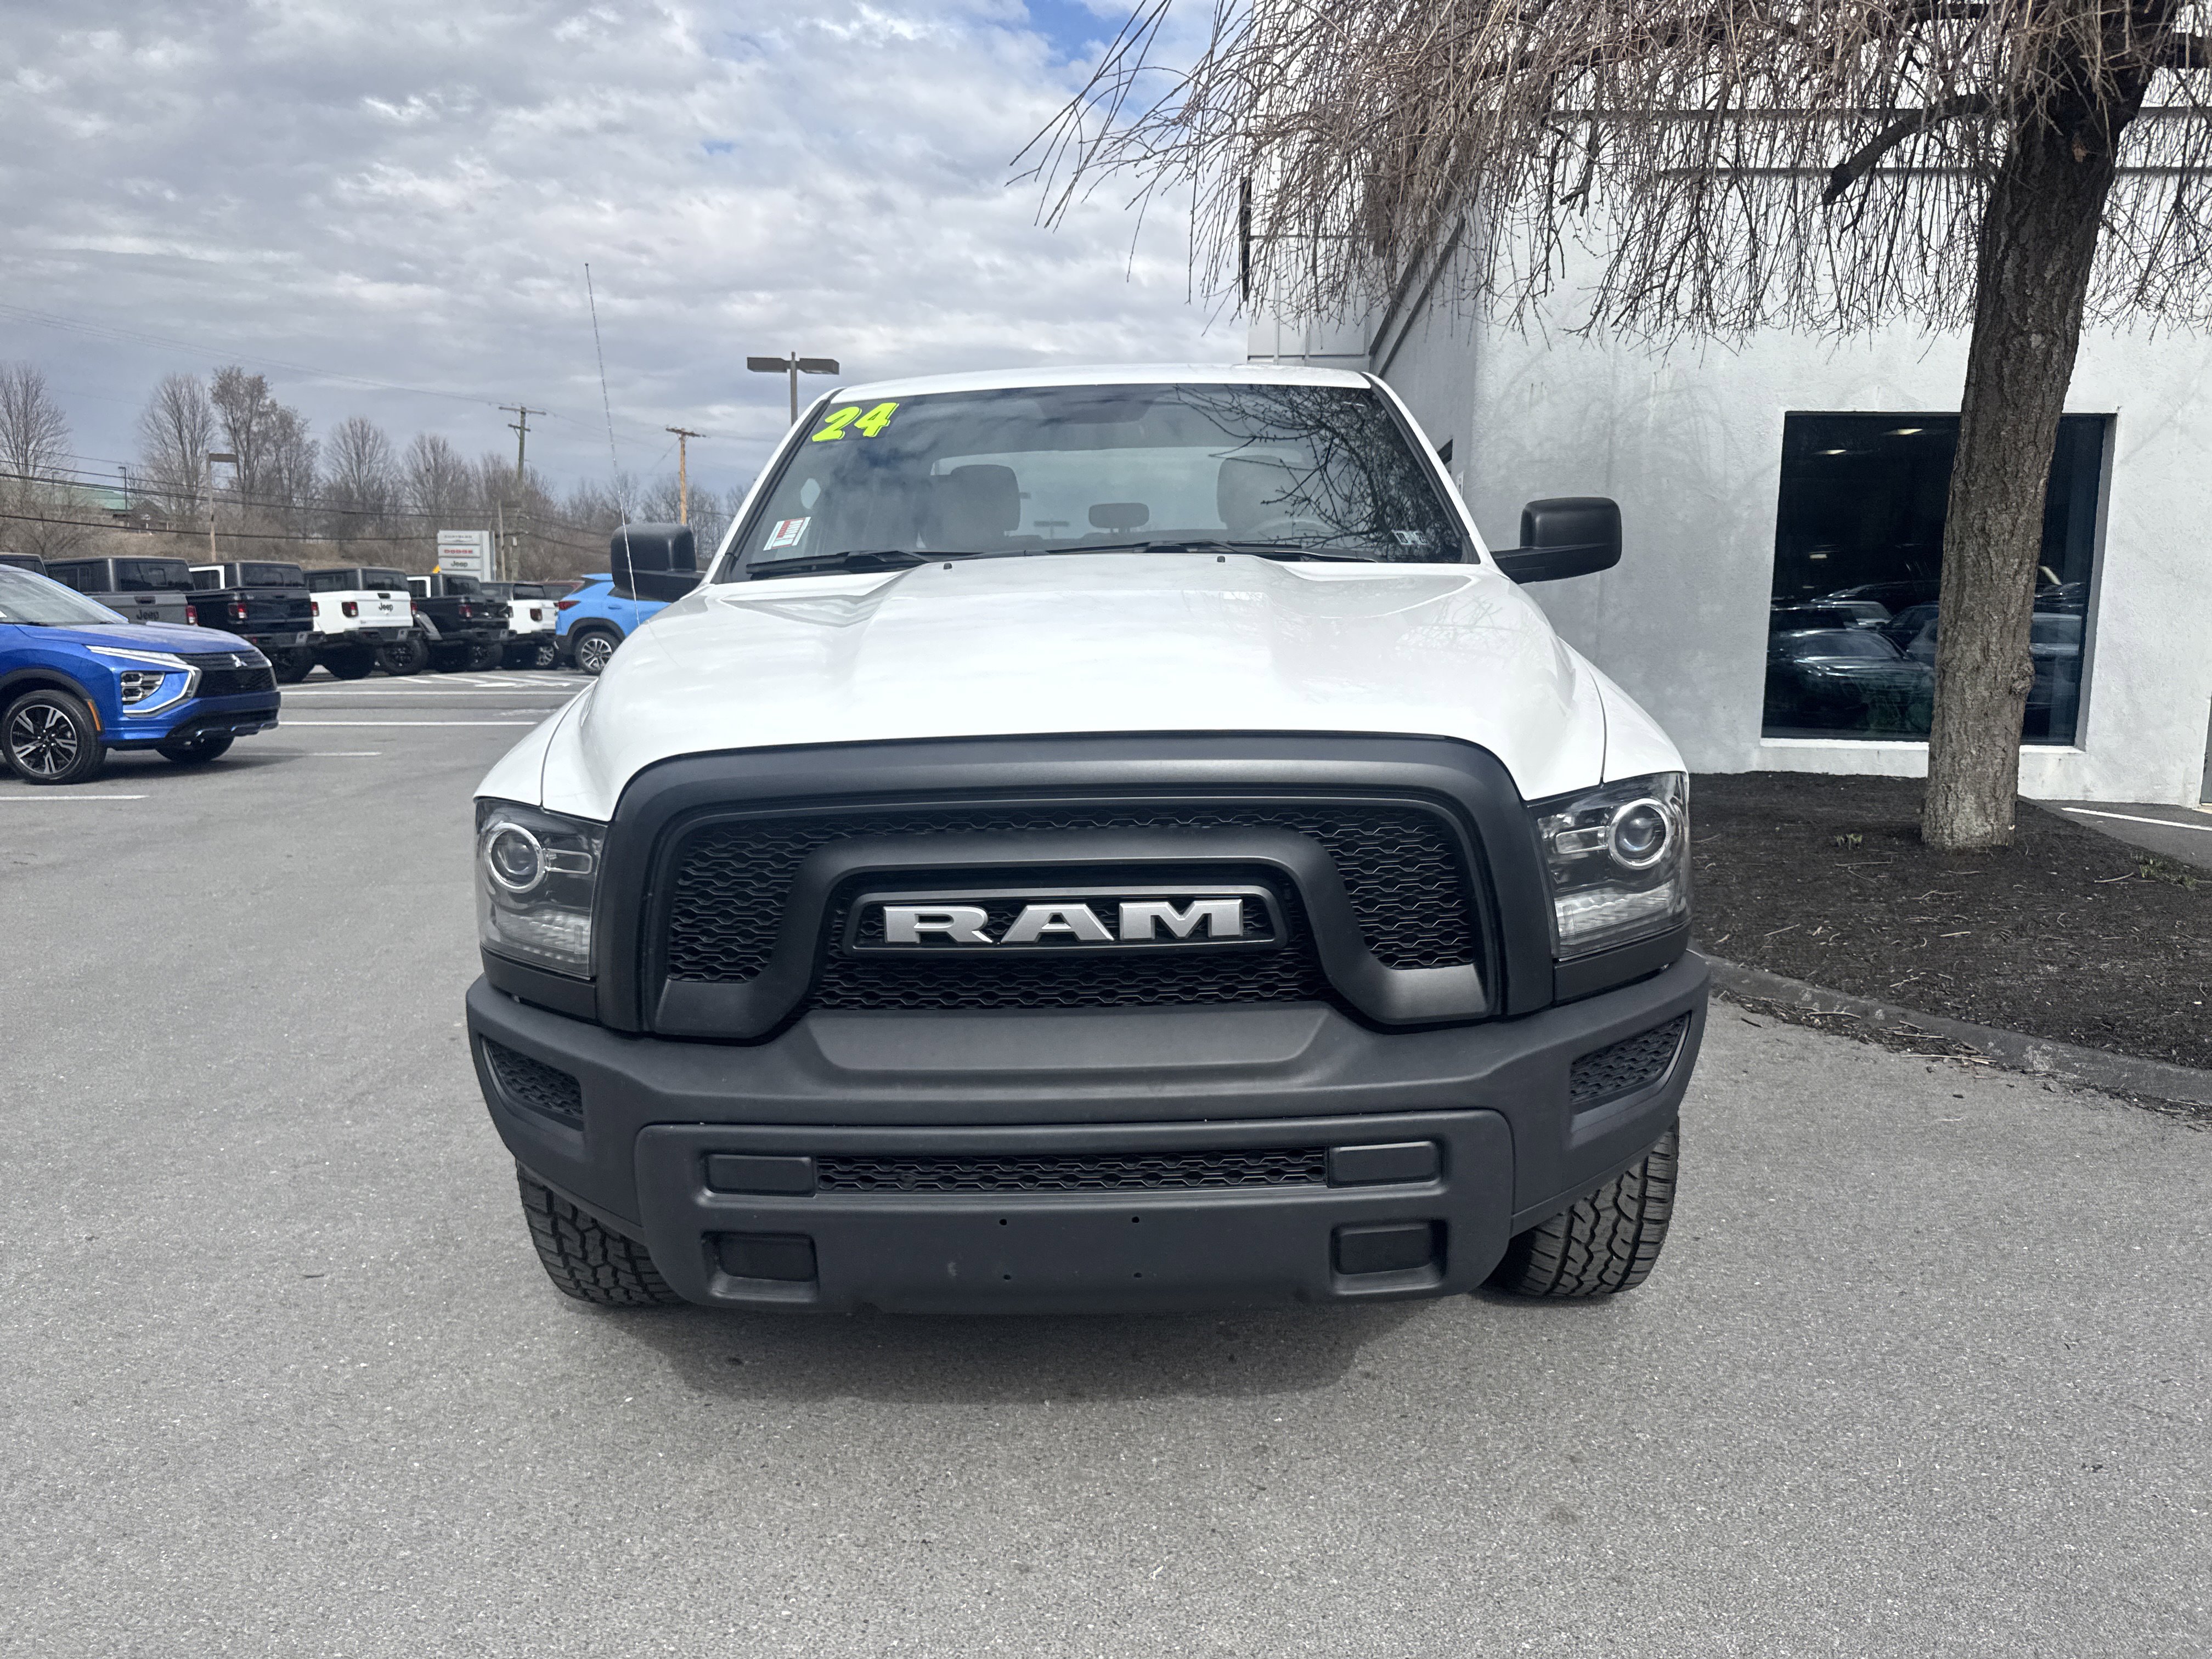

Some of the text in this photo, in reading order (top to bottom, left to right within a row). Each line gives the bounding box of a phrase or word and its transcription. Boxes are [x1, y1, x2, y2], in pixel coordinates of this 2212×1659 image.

[812, 403, 899, 442] 24
[136, 609, 159, 620] Jeep
[379, 602, 393, 612] Jeep
[883, 899, 1244, 944] RAM
